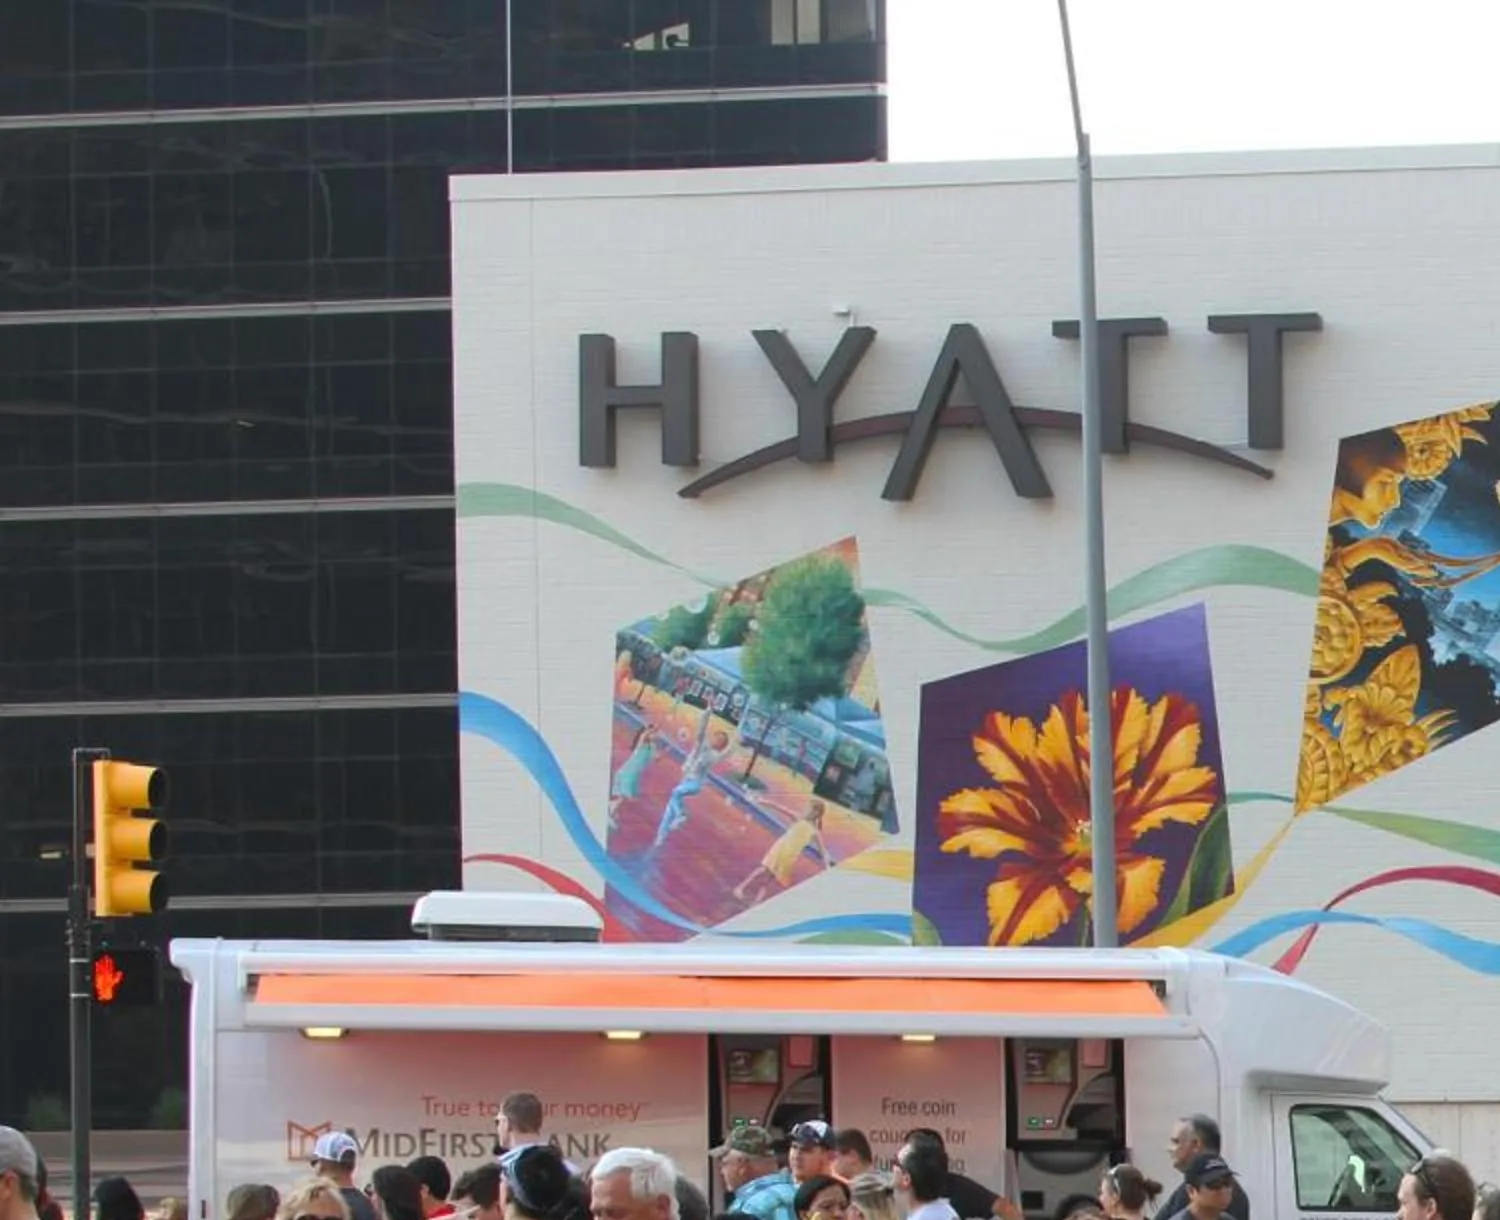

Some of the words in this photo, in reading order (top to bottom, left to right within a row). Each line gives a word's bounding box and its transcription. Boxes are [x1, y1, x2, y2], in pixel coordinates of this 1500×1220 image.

[578, 312, 1324, 502] HYATT
[421, 1096, 470, 1117] True
[478, 1099, 498, 1117] to
[565, 1101, 641, 1121] money
[881, 1097, 919, 1116] Free
[921, 1099, 957, 1116] coin
[548, 1132, 611, 1158] ANK
[944, 1127, 966, 1144] for
